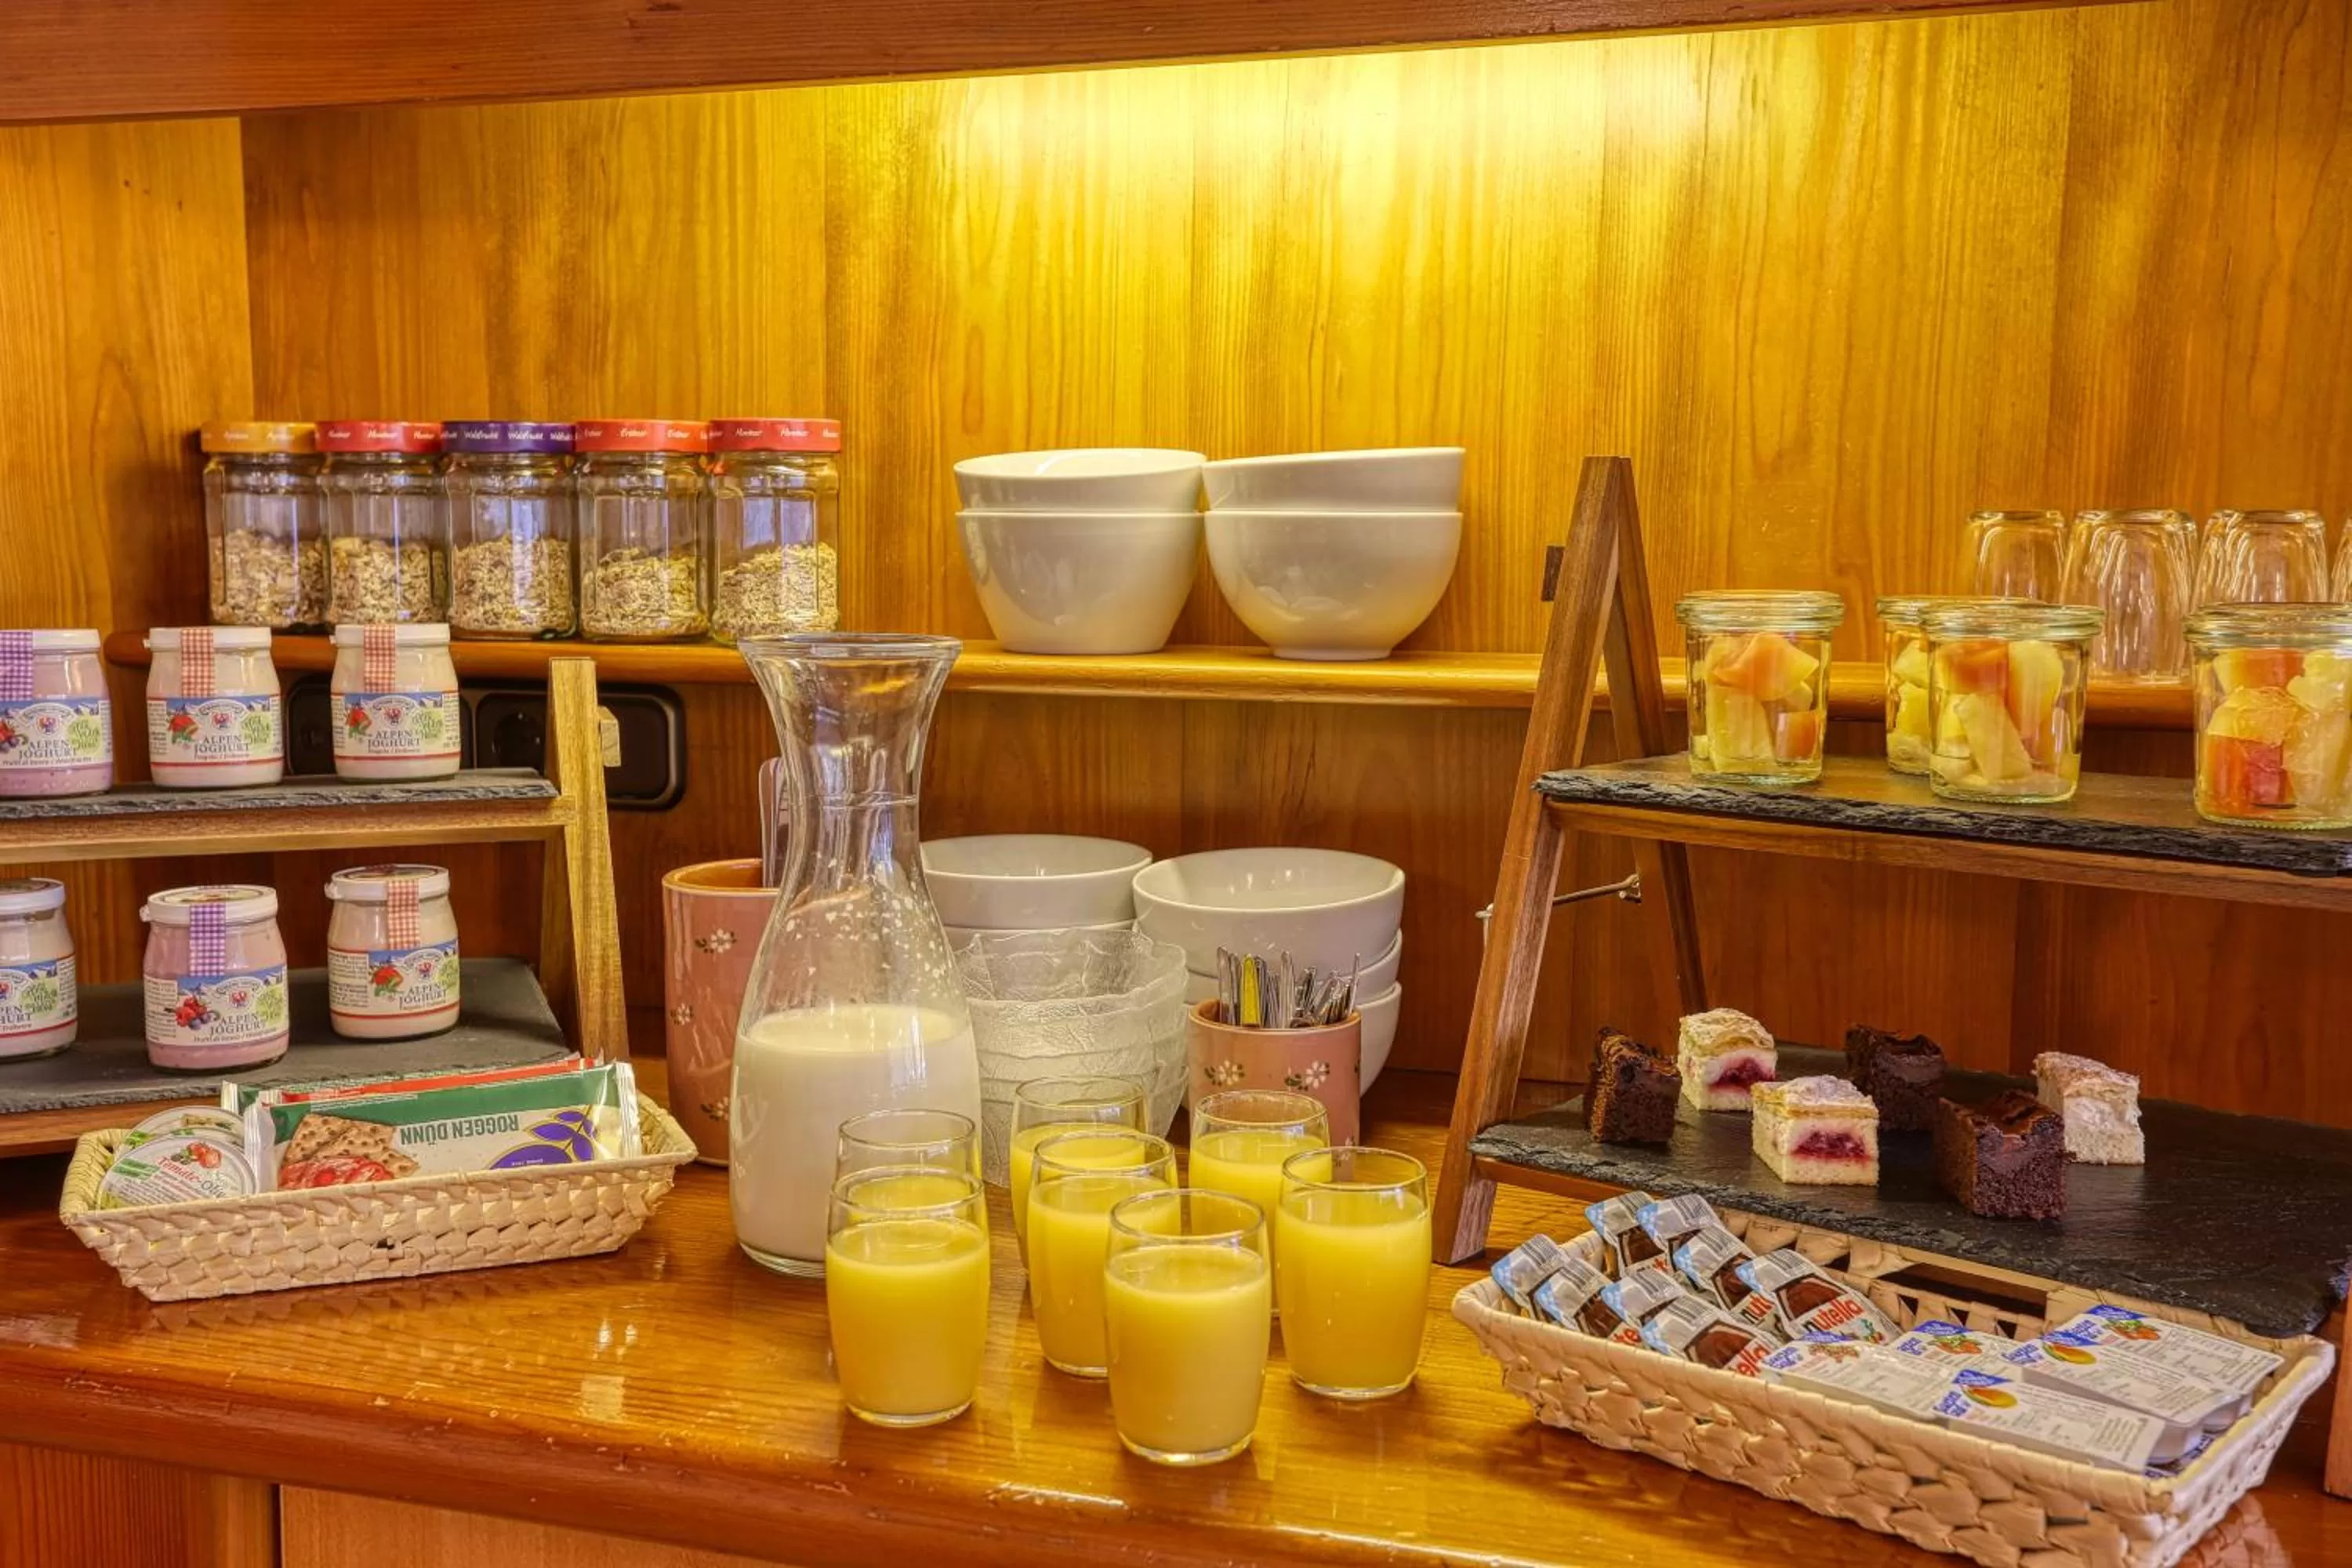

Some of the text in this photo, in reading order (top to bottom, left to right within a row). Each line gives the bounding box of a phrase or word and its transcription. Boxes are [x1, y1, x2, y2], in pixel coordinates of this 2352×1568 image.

[203, 734, 242, 744] ALPEN
[376, 730, 412, 739] ALPEN
[27, 739, 71, 753] ALPEN
[194, 742, 250, 753] JOGHURT
[368, 739, 420, 750] JOGHURT
[19, 747, 77, 760] JOGHURT
[408, 982, 442, 995] ALPEN
[399, 989, 447, 1008] JOGHURT
[220, 1012, 259, 1025] ALPEN
[452, 1114, 519, 1139] ROGGEN
[400, 1122, 448, 1145] DÜNN
[1802, 1299, 1864, 1334] nutella
